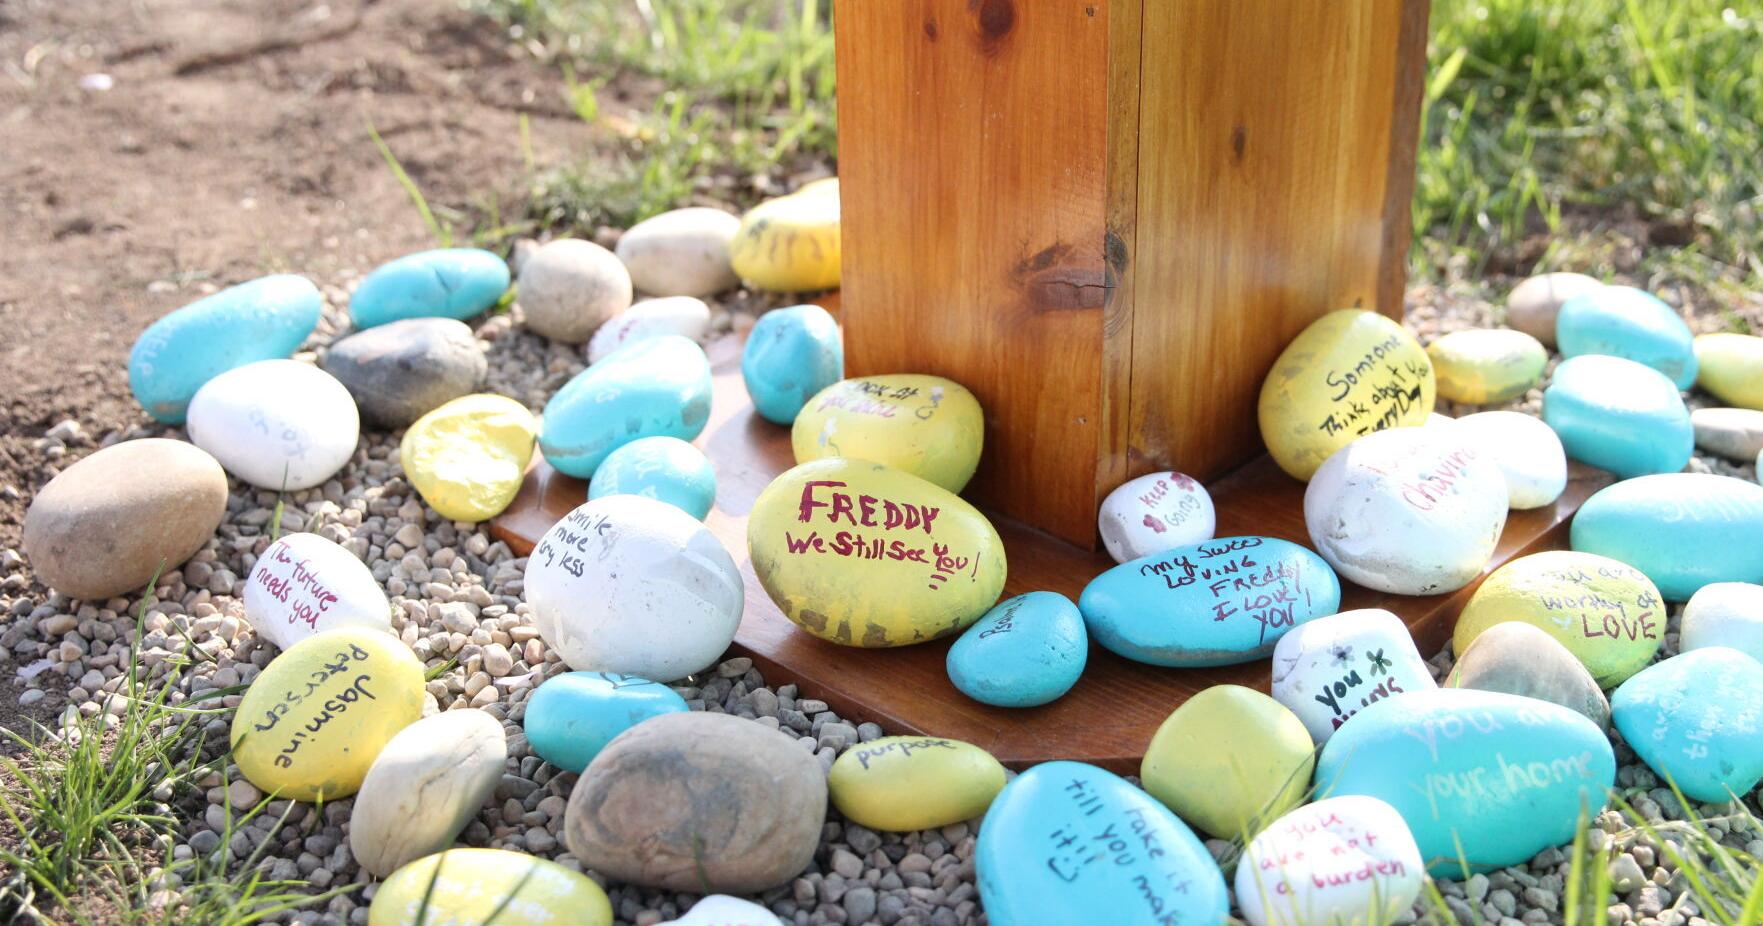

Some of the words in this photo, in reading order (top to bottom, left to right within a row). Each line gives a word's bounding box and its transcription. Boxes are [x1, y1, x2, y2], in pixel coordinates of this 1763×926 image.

[797, 480, 940, 534] FREDDY
[554, 526, 589, 553] more
[785, 530, 825, 555] We
[828, 530, 885, 561] Still
[886, 540, 930, 565] See
[558, 550, 585, 578] less
[256, 567, 292, 604] needs
[288, 597, 320, 630] you
[291, 559, 338, 612] future
[1211, 600, 1239, 623] I
[1581, 611, 1657, 642] LOVE
[273, 674, 377, 769] Jasmine
[1495, 751, 1597, 796] home
[1063, 778, 1105, 817] till
[1131, 874, 1186, 926] mak
[1311, 859, 1406, 890] burden
